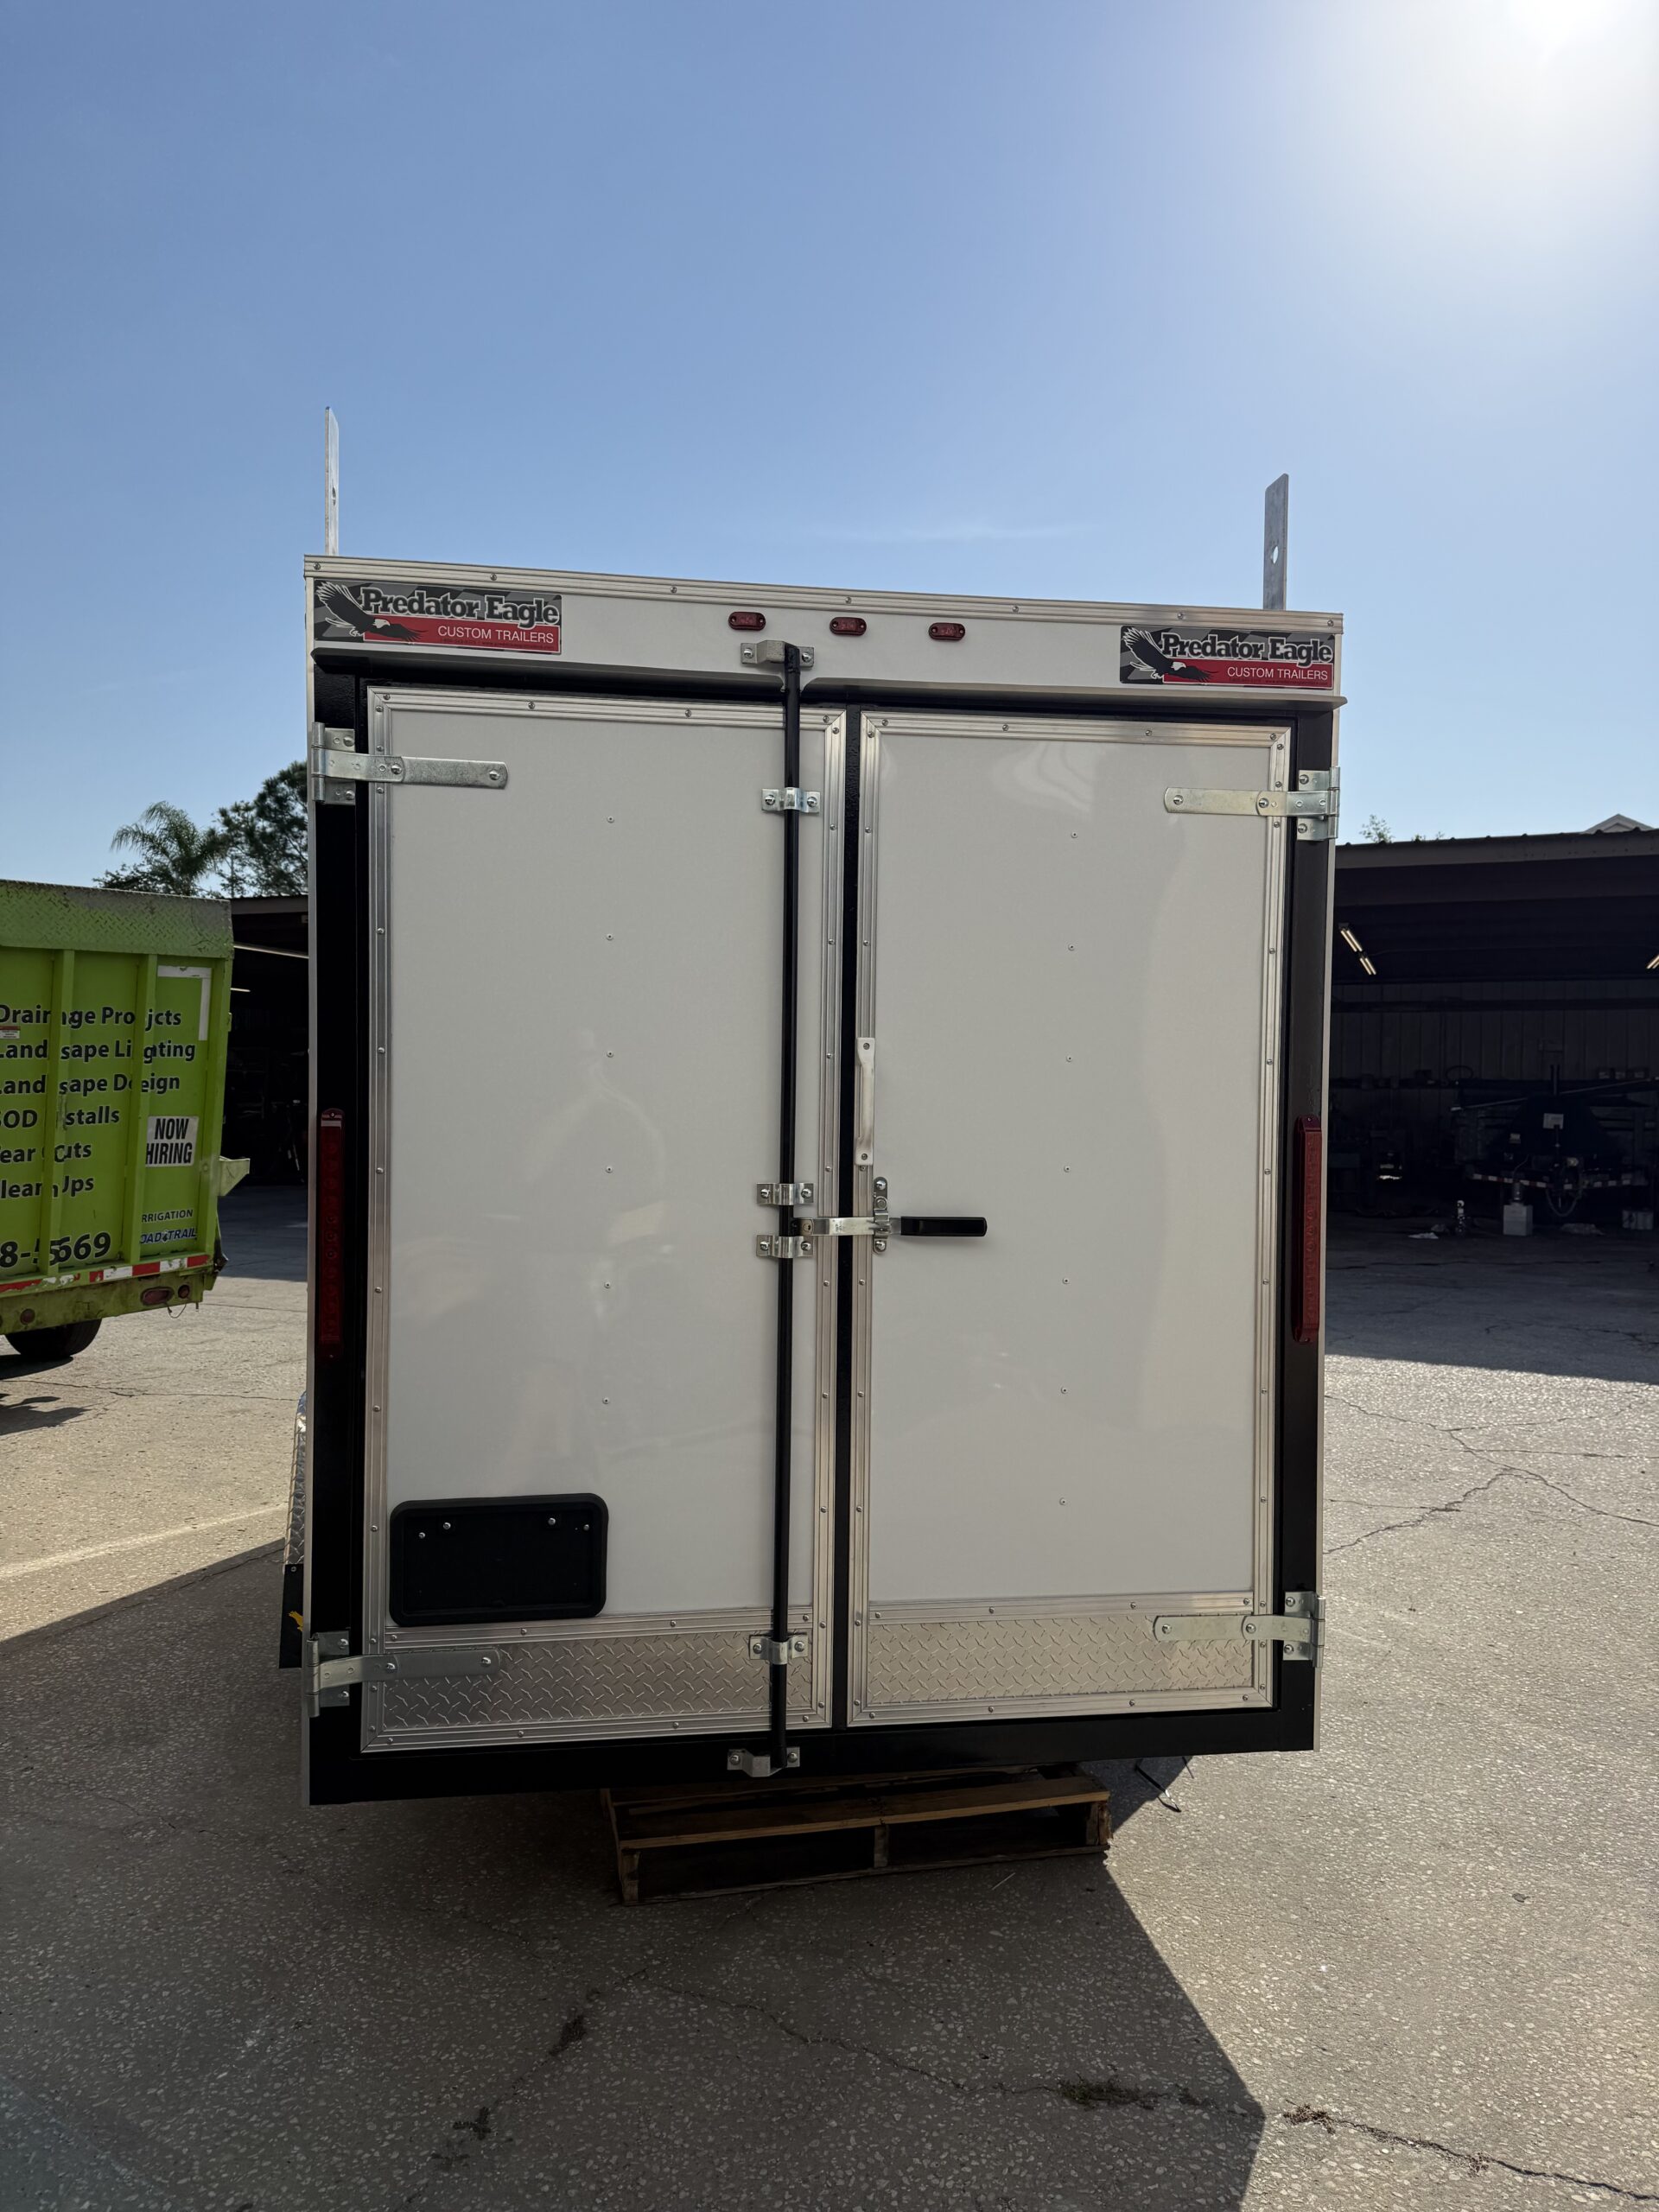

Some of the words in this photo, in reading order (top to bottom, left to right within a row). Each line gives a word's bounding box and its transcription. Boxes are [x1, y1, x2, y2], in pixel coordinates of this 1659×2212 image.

[360, 587, 480, 620] Predator
[485, 594, 561, 630] Eagle
[437, 626, 492, 640] CUSTOM
[494, 629, 555, 644] TRAILERS
[1160, 632, 1265, 661] Predator
[1268, 637, 1333, 668] Eagle
[1227, 666, 1274, 679] CUSTOM
[1276, 668, 1328, 681] TRAILERS
[101, 1007, 181, 1031] Projcts
[154, 1118, 189, 1140] NOW
[145, 1142, 193, 1165] HIRING
[141, 1209, 194, 1223] RRIGATION
